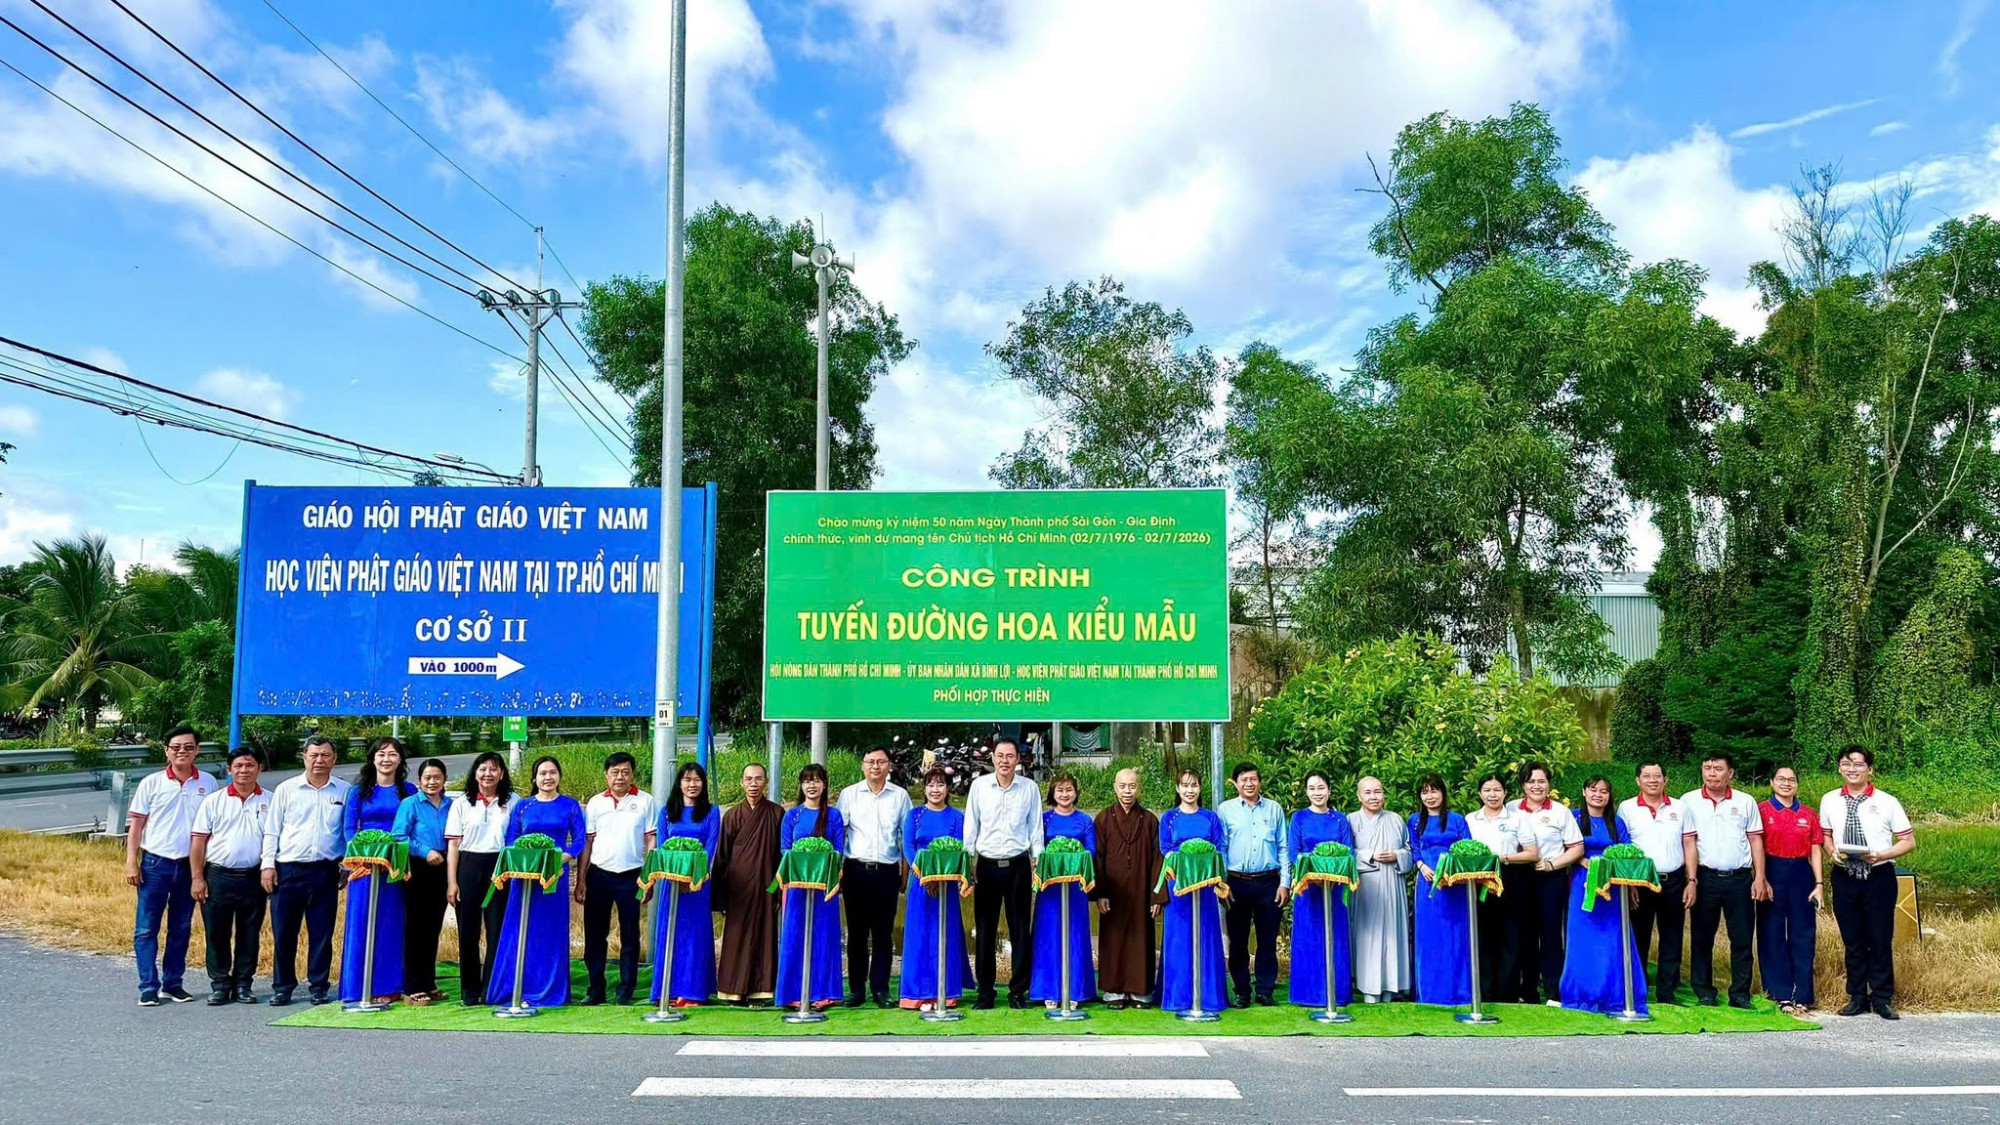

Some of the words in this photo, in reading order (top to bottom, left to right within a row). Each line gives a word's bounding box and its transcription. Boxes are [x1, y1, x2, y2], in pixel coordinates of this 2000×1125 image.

[303, 501, 352, 528] GIÁO
[364, 500, 399, 533] HỘI
[411, 501, 465, 533] PHẬT
[477, 501, 527, 528] GIÁO
[539, 502, 586, 534] VIỆT
[599, 508, 647, 529] NAM
[817, 517, 849, 528] Chào
[851, 518, 884, 530] mừng
[886, 517, 900, 529] kỷ
[902, 516, 930, 529] niệm
[932, 516, 947, 527] 50
[949, 517, 975, 527] năm
[977, 516, 1007, 530] Ngày
[1010, 516, 1044, 527] Thành
[1047, 515, 1069, 529] phố
[1072, 516, 1090, 527] Sài
[1092, 516, 1117, 527] Gòn
[1126, 516, 1147, 527] Gia
[1149, 516, 1176, 530] Định
[783, 534, 814, 544] chính
[817, 533, 845, 546] thức,
[848, 533, 872, 544] vinh
[874, 533, 890, 546] dự
[892, 535, 925, 546] mang
[927, 532, 946, 544] tên
[948, 531, 972, 543] Chủ
[974, 532, 996, 546] tịch
[998, 530, 1015, 543] Hồ
[1017, 531, 1037, 543] Chí
[1039, 532, 1067, 543] Minh
[1069, 532, 1136, 545] (02/7/1976
[1144, 532, 1211, 545] 02/7/2026)
[266, 560, 299, 597] HỌC
[306, 553, 342, 597] VIỆN
[348, 553, 390, 597] PHẬT
[394, 553, 432, 592] GIÁO
[438, 553, 474, 598] VIỆT
[480, 561, 517, 592] NAM
[524, 561, 549, 598] TẠI
[556, 549, 604, 593] TP.HỒ
[610, 555, 638, 593] CHÍ
[643, 562, 684, 593] MI
[902, 564, 995, 587] CÔNG
[1005, 563, 1089, 587] TRÌNH
[416, 615, 452, 641] CƠ
[457, 610, 493, 641] SỞ
[502, 619, 527, 641] II
[798, 600, 877, 640] TUYẾN
[887, 604, 988, 640] ĐƯỜNG
[998, 612, 1057, 640] HOA
[1068, 596, 1124, 641] KIỂU
[1135, 599, 1195, 641] MẪU
[420, 659, 446, 673] VÀO
[933, 684, 961, 702] PHỐI
[964, 689, 989, 706] HỢP
[990, 688, 1021, 705] THỰC
[1024, 686, 1050, 705] HIỆN
[659, 710, 668, 719] 01
